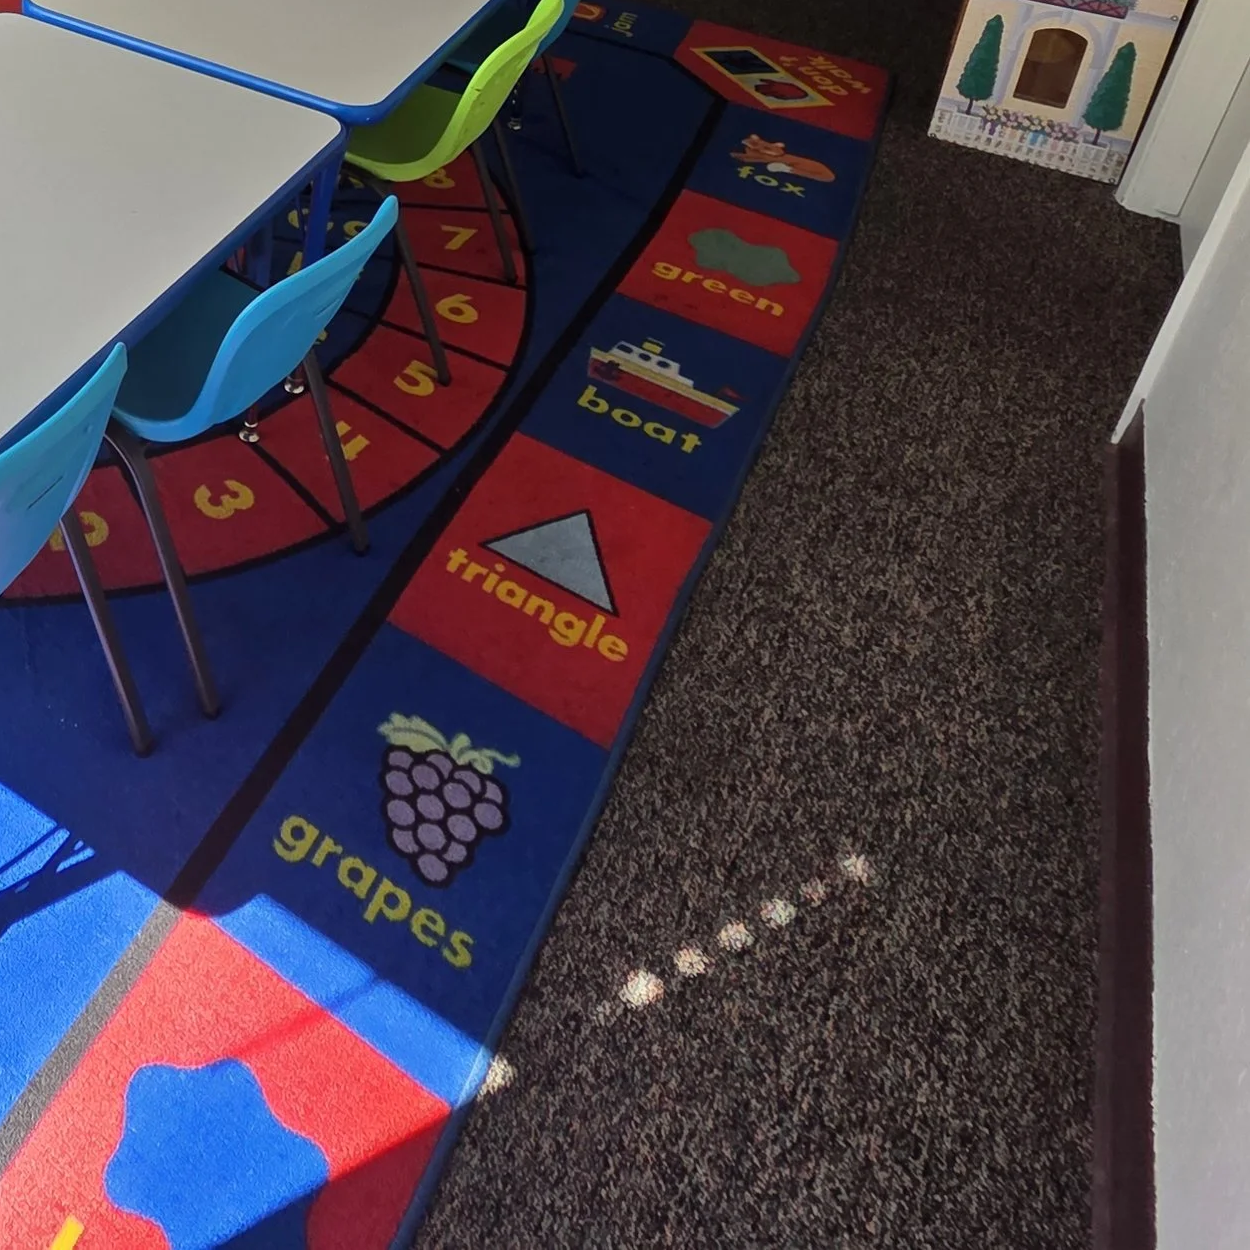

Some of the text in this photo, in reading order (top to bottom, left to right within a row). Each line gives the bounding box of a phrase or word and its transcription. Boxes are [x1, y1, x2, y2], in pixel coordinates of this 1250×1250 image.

[604, 12, 637, 37] jam
[738, 165, 806, 197] fox
[441, 224, 478, 251] 7
[435, 293, 479, 324] 6
[653, 261, 785, 317] green
[392, 360, 441, 398] 5
[576, 384, 703, 455] boat
[194, 479, 255, 520] 3
[446, 547, 629, 662] triangle
[272, 813, 476, 970] grapes
